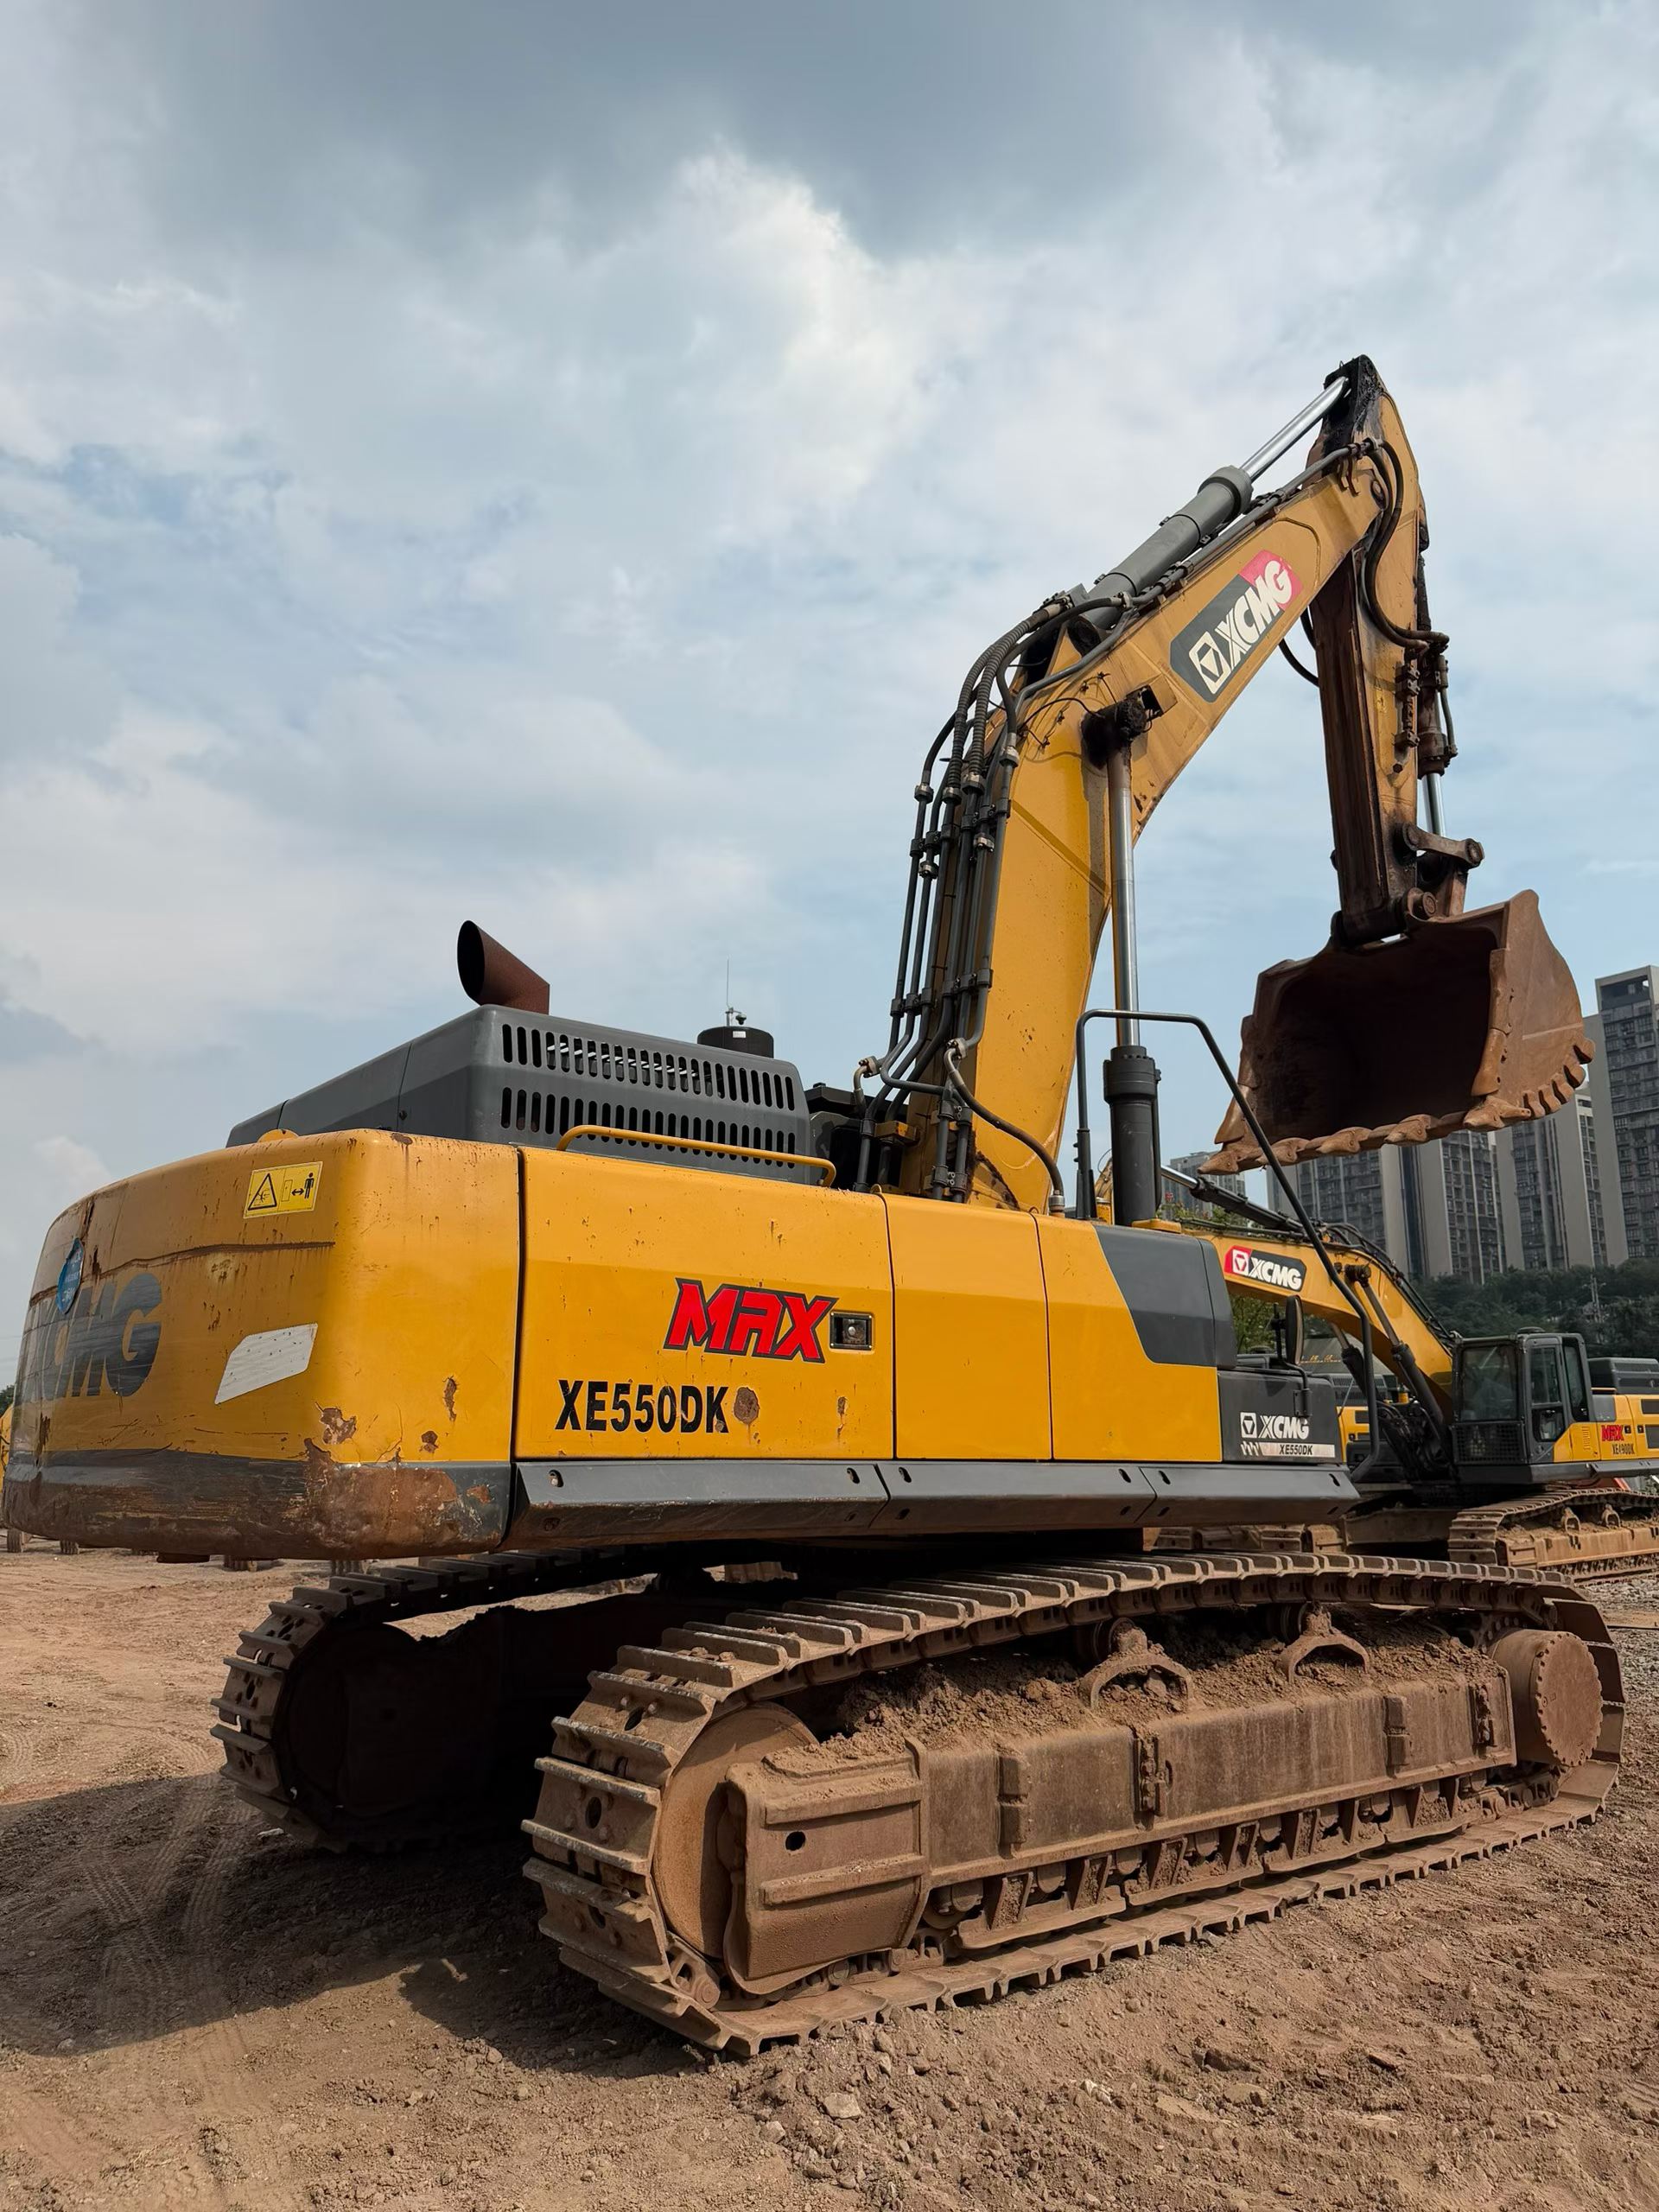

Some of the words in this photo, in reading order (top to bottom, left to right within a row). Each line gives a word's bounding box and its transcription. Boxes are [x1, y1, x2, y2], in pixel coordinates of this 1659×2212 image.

[1215, 561, 1293, 671] XCMG
[1249, 1256, 1303, 1291] XCMG
[663, 1277, 839, 1363] MAX
[555, 1379, 730, 1434] XE550DK
[1258, 1415, 1310, 1440] XCMG
[1280, 1444, 1313, 1456] XE550DK
